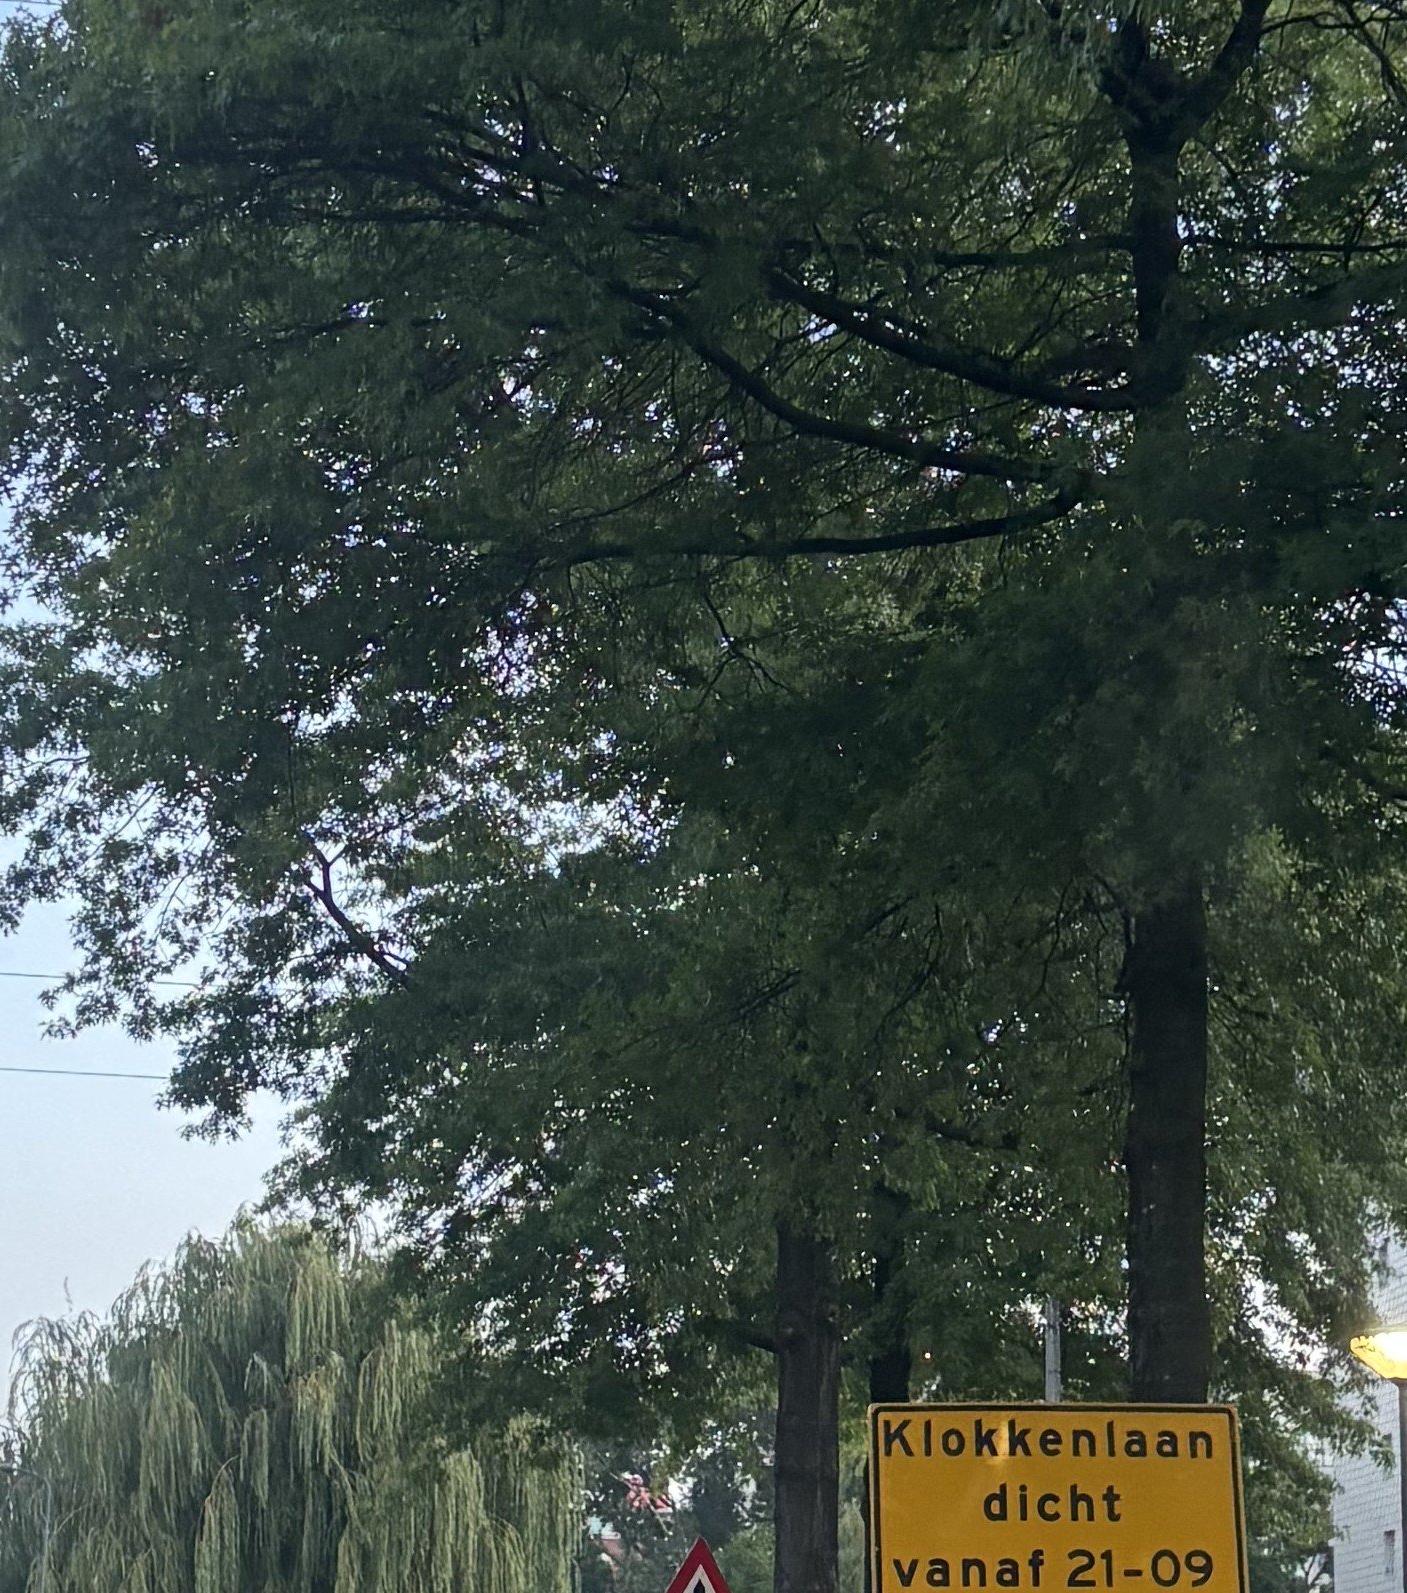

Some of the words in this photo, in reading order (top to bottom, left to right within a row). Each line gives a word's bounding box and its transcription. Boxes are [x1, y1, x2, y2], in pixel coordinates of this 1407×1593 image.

[882, 1418, 1214, 1460] Klokkenlaan
[983, 1482, 1122, 1522] dicht
[893, 1548, 1045, 1588] vanaf
[1067, 1549, 1214, 1588] 21-09
